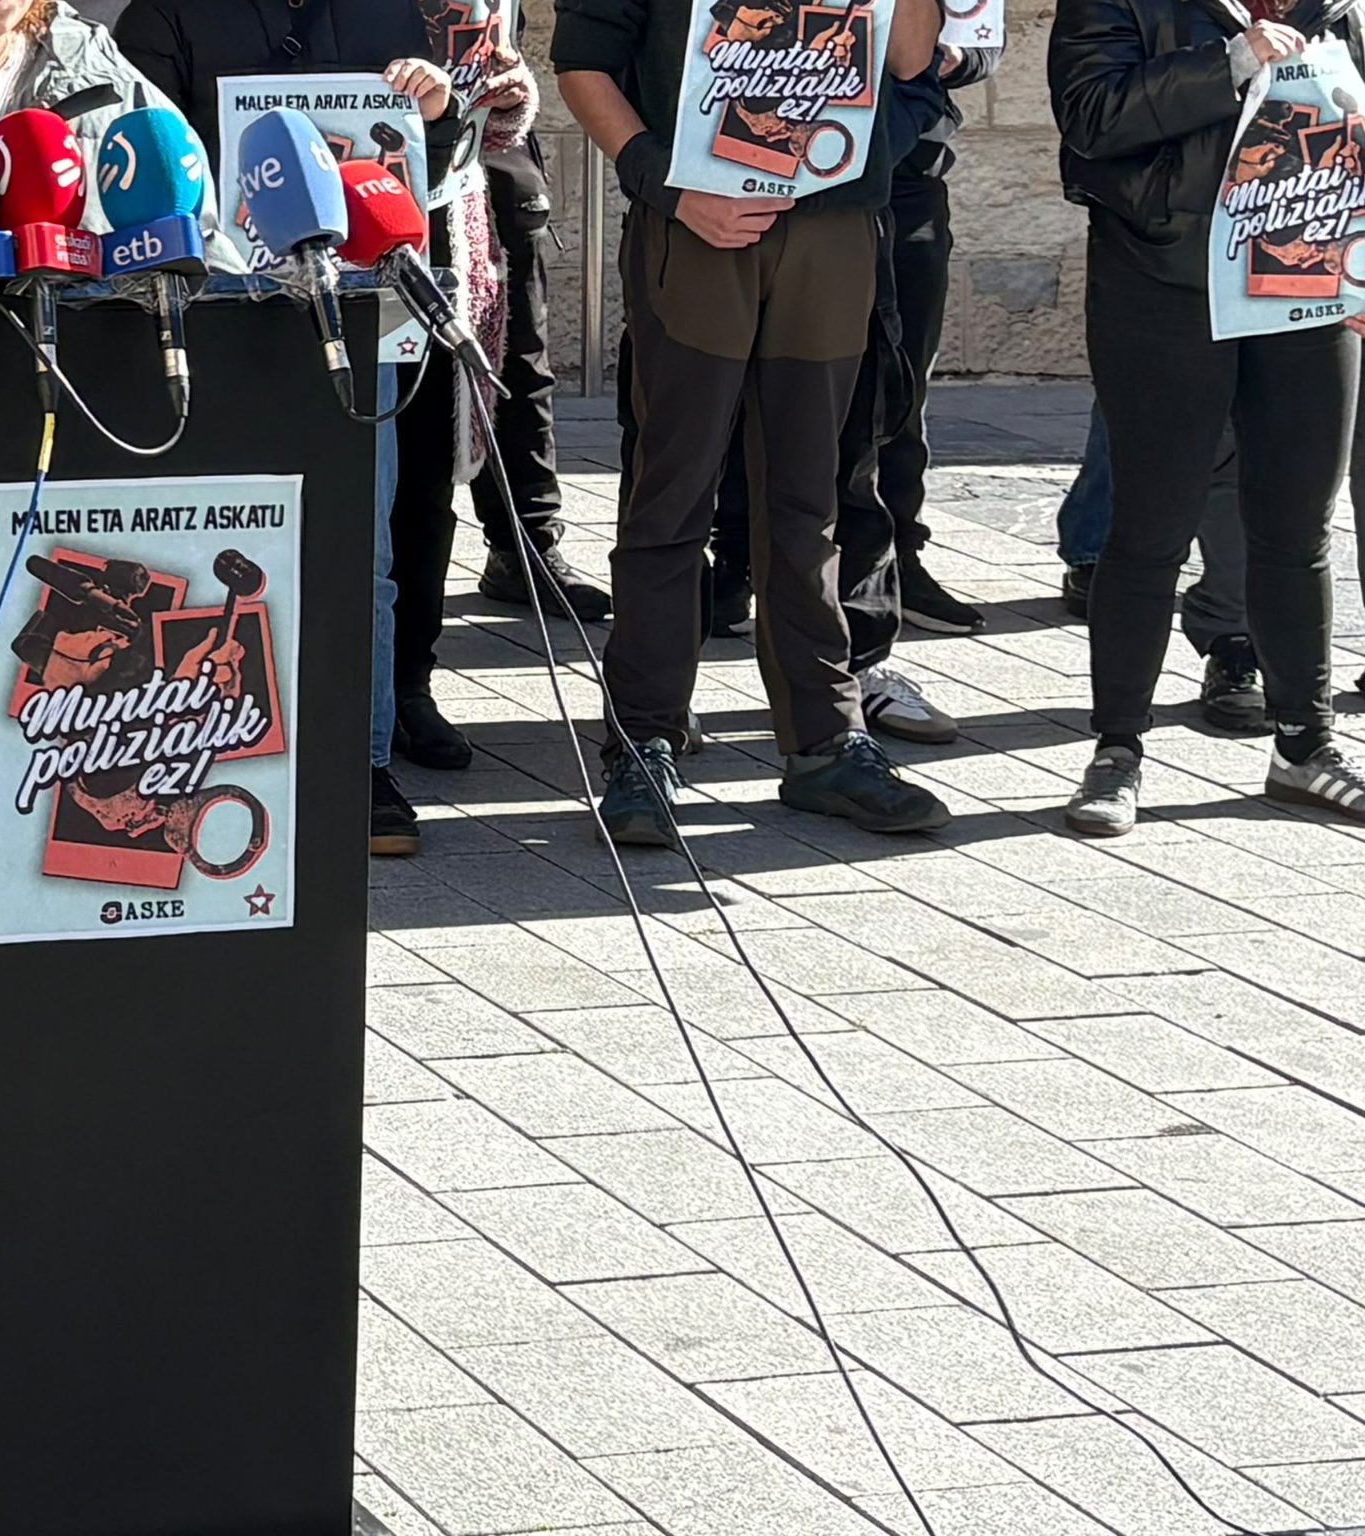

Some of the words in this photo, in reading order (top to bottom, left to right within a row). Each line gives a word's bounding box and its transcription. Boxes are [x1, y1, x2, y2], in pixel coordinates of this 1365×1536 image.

[710, 41, 834, 70] Muntai
[235, 95, 282, 111] MALEN
[286, 94, 310, 110] ETA
[314, 94, 358, 110] ARATZ
[362, 94, 412, 110] ASKATU
[701, 66, 864, 113] polizialik
[778, 97, 825, 121] ez!
[1228, 156, 1346, 213] Muntai
[1303, 210, 1349, 242] ez!
[112, 231, 163, 266] etb
[1305, 304, 1345, 319] ASKE
[11, 509, 81, 536] MALEN
[87, 508, 124, 533] ETA
[130, 506, 197, 532] ARATZ
[203, 504, 285, 530] ASKATU
[20, 661, 216, 736] Muntai
[16, 694, 267, 808] polizialik
[138, 750, 211, 794] ez!
[125, 900, 185, 921] ASKE
